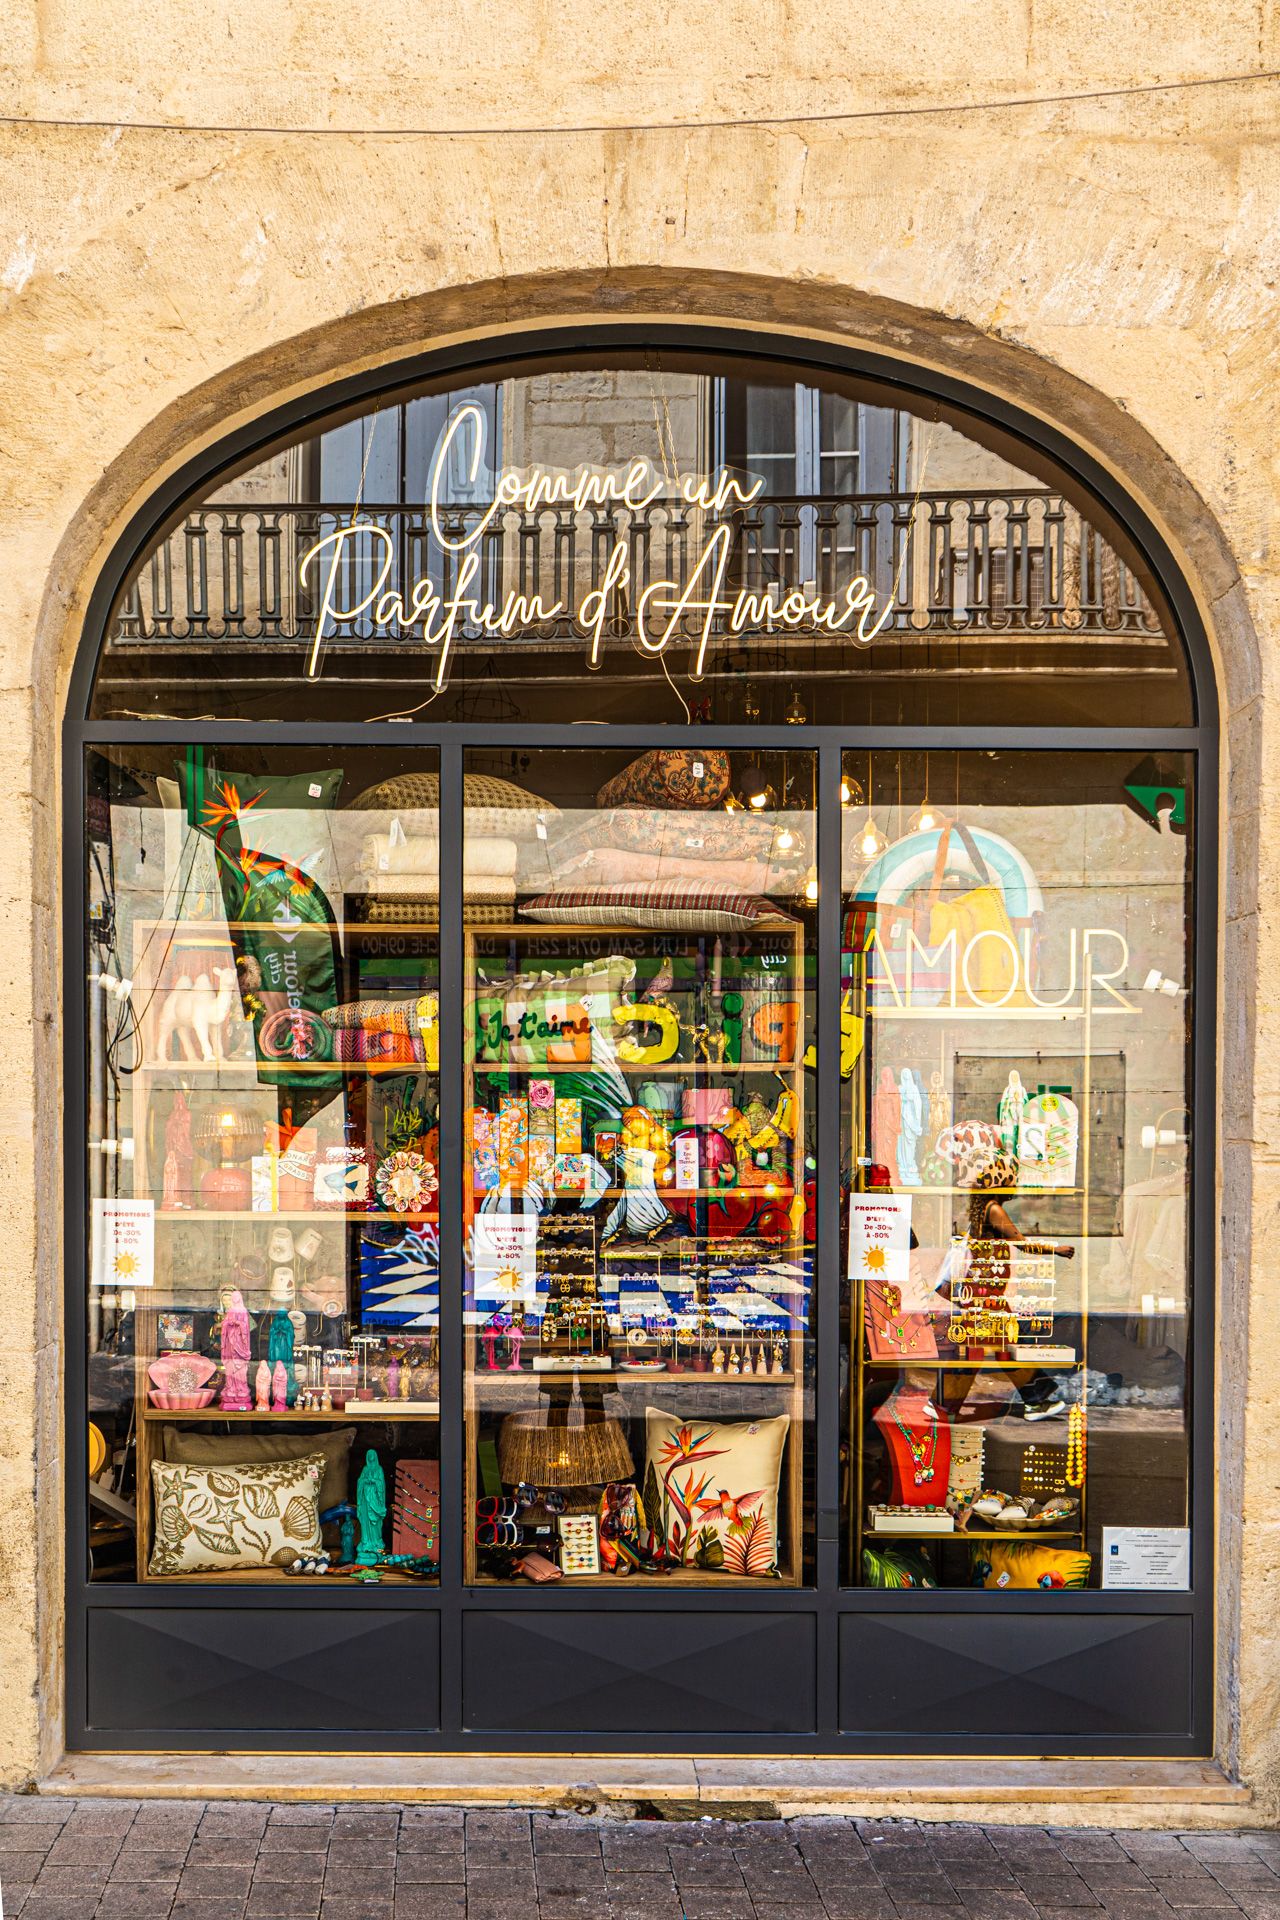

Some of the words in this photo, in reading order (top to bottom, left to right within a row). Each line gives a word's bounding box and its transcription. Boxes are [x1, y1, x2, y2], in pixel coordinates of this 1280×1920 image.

[430, 405, 663, 551] Comme
[684, 468, 765, 512] un
[300, 524, 561, 688] Parfum
[842, 927, 1135, 1008] AMOUR
[487, 1013, 514, 1048] Je
[518, 1011, 594, 1040] t'aime
